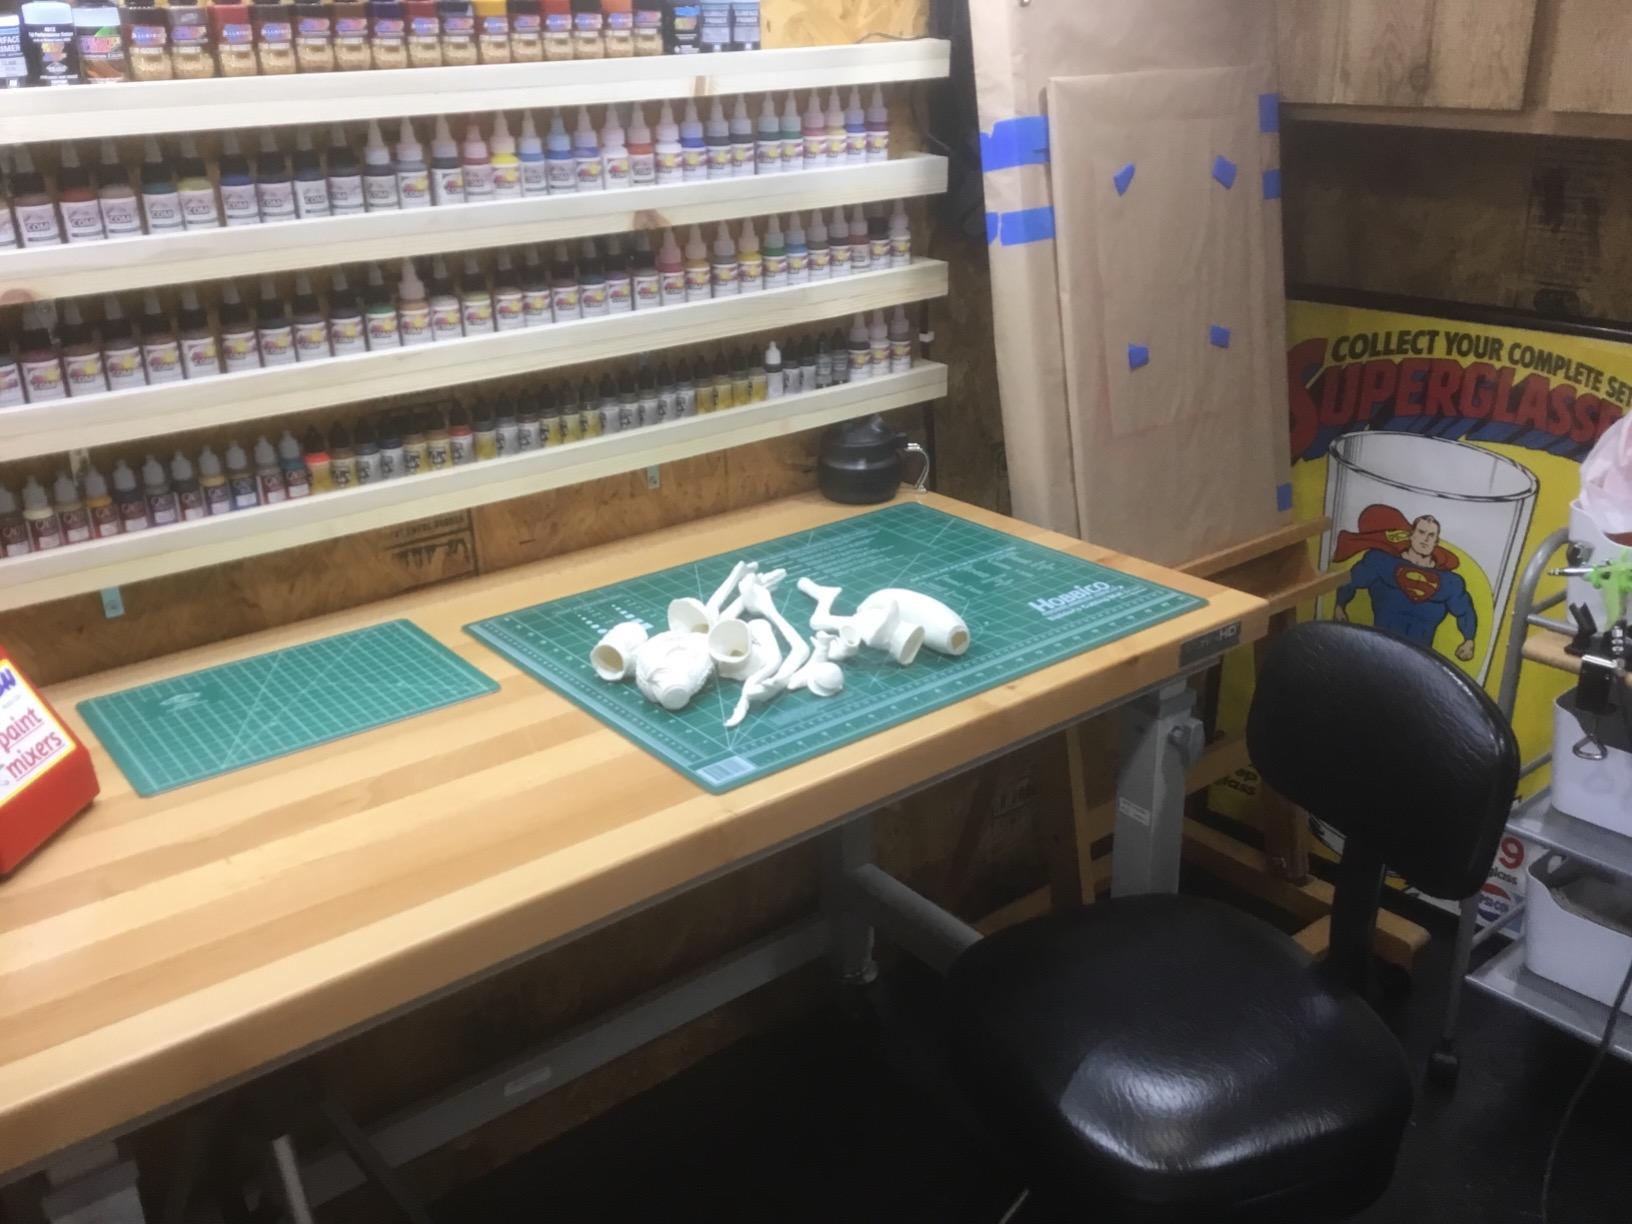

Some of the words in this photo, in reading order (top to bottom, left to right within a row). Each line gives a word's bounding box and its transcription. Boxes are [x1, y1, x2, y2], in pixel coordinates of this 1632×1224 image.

[1331, 330, 1439, 362] COLLECT
[1444, 331, 1504, 361] YOUR
[1507, 342, 1604, 394] COMPLETE
[0, 707, 43, 754] paint
[6, 731, 62, 778] mixers
[1499, 836, 1525, 869] 9
